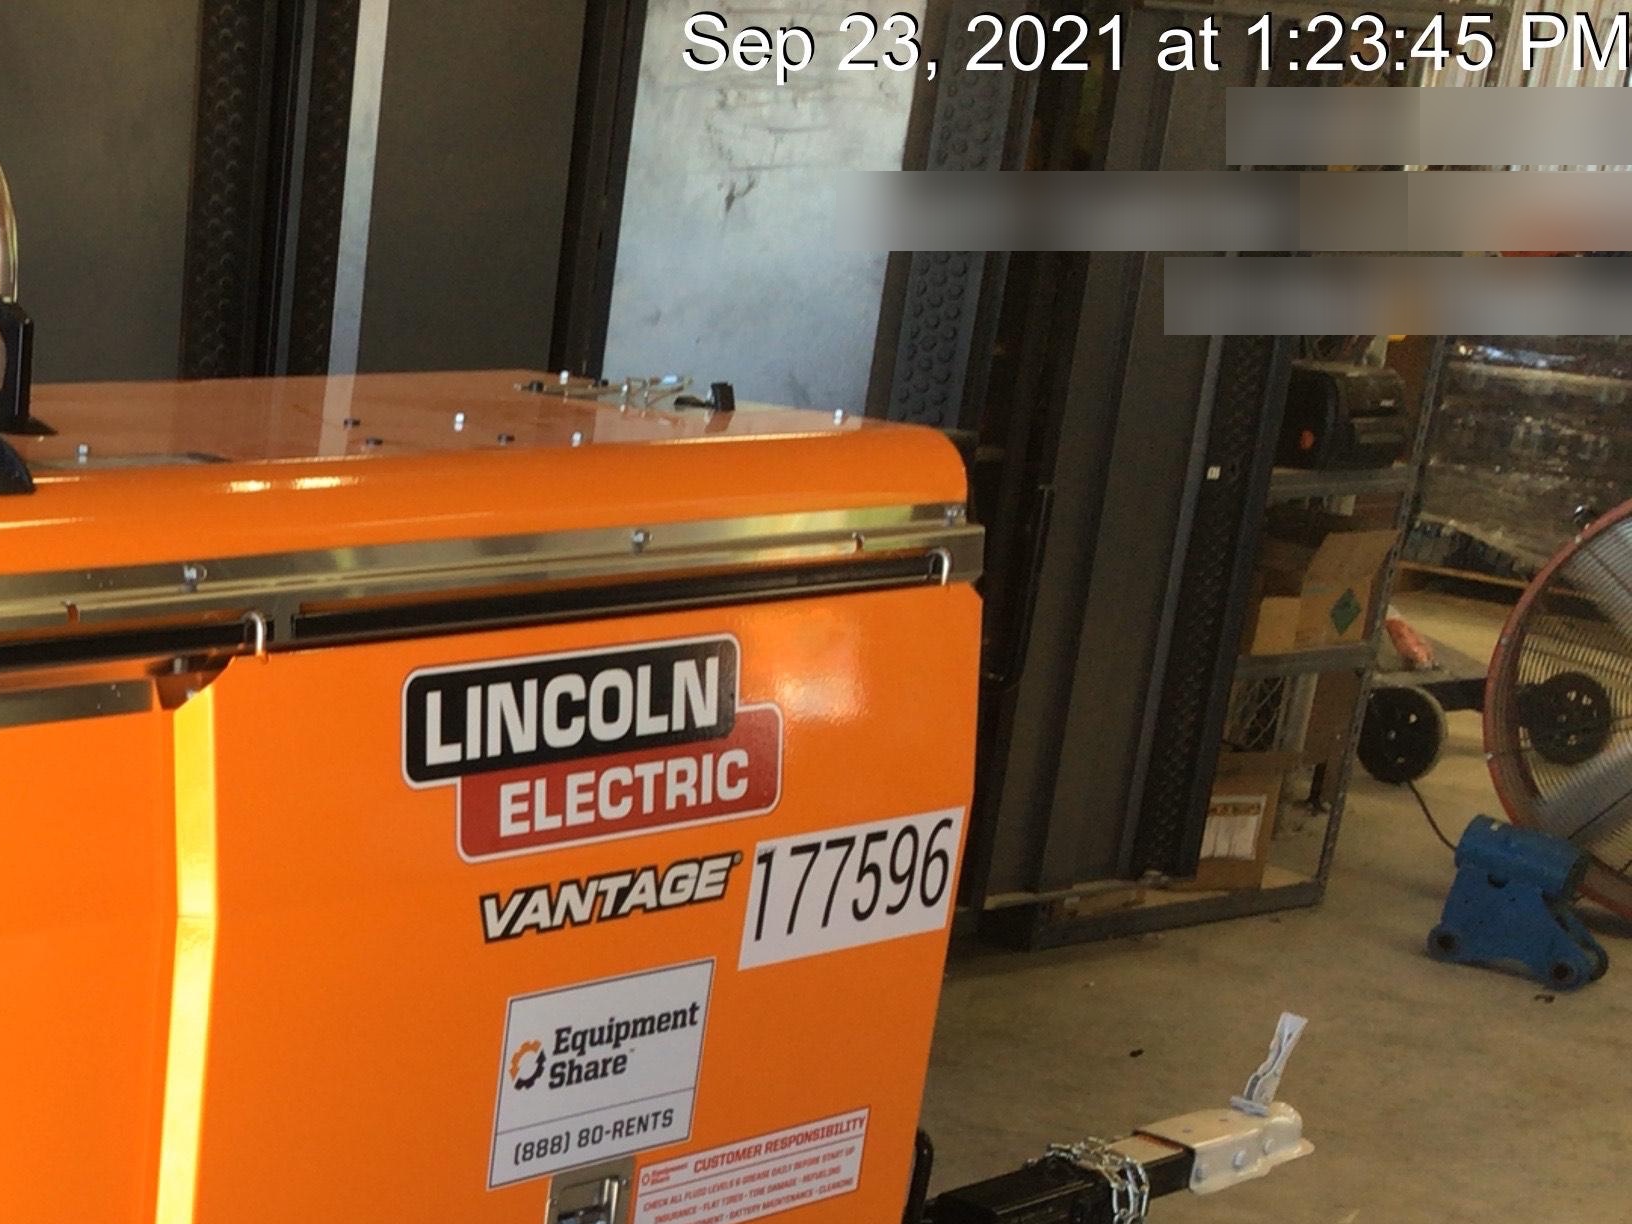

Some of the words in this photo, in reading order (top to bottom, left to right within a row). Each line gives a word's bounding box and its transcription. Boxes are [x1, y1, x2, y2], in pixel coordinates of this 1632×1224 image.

[424, 655, 720, 767] LINCOLN
[498, 747, 750, 838] ELECTRIC
[480, 857, 735, 942] VANTAGE
[753, 818, 954, 943] 177596
[552, 1001, 701, 1058] Equipment
[548, 1053, 628, 1090] Share
[513, 1131, 571, 1166] (888)
[576, 1108, 675, 1149] 80-RENTS
[694, 1143, 762, 1174] CUSTOMER
[764, 1116, 866, 1154] RESPONSIBILITY
